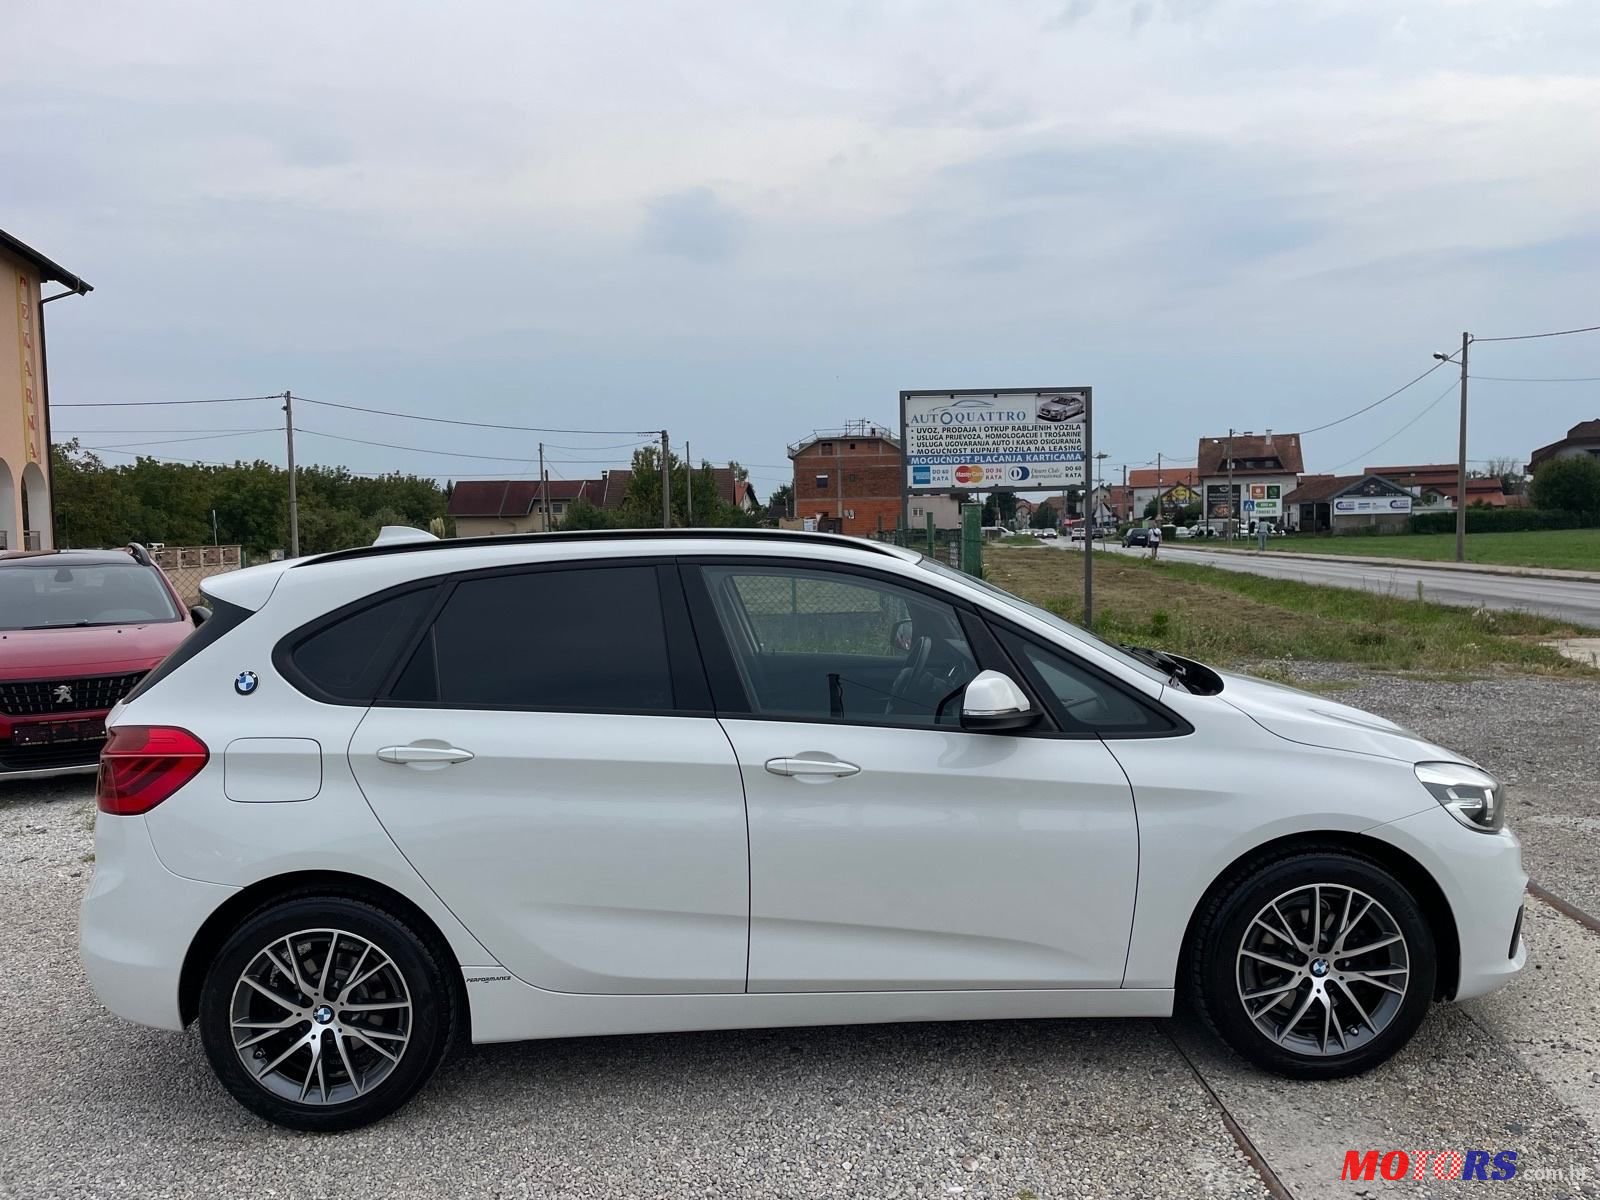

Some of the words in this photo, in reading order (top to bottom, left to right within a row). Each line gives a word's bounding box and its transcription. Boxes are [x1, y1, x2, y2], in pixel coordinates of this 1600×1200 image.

[911, 411, 1026, 425] AUTOQUATTRO
[1011, 424, 1052, 432] RABLJENIH
[945, 433, 984, 441] PRIJEVOZA,
[1025, 453, 1082, 462] KARTICAMA
